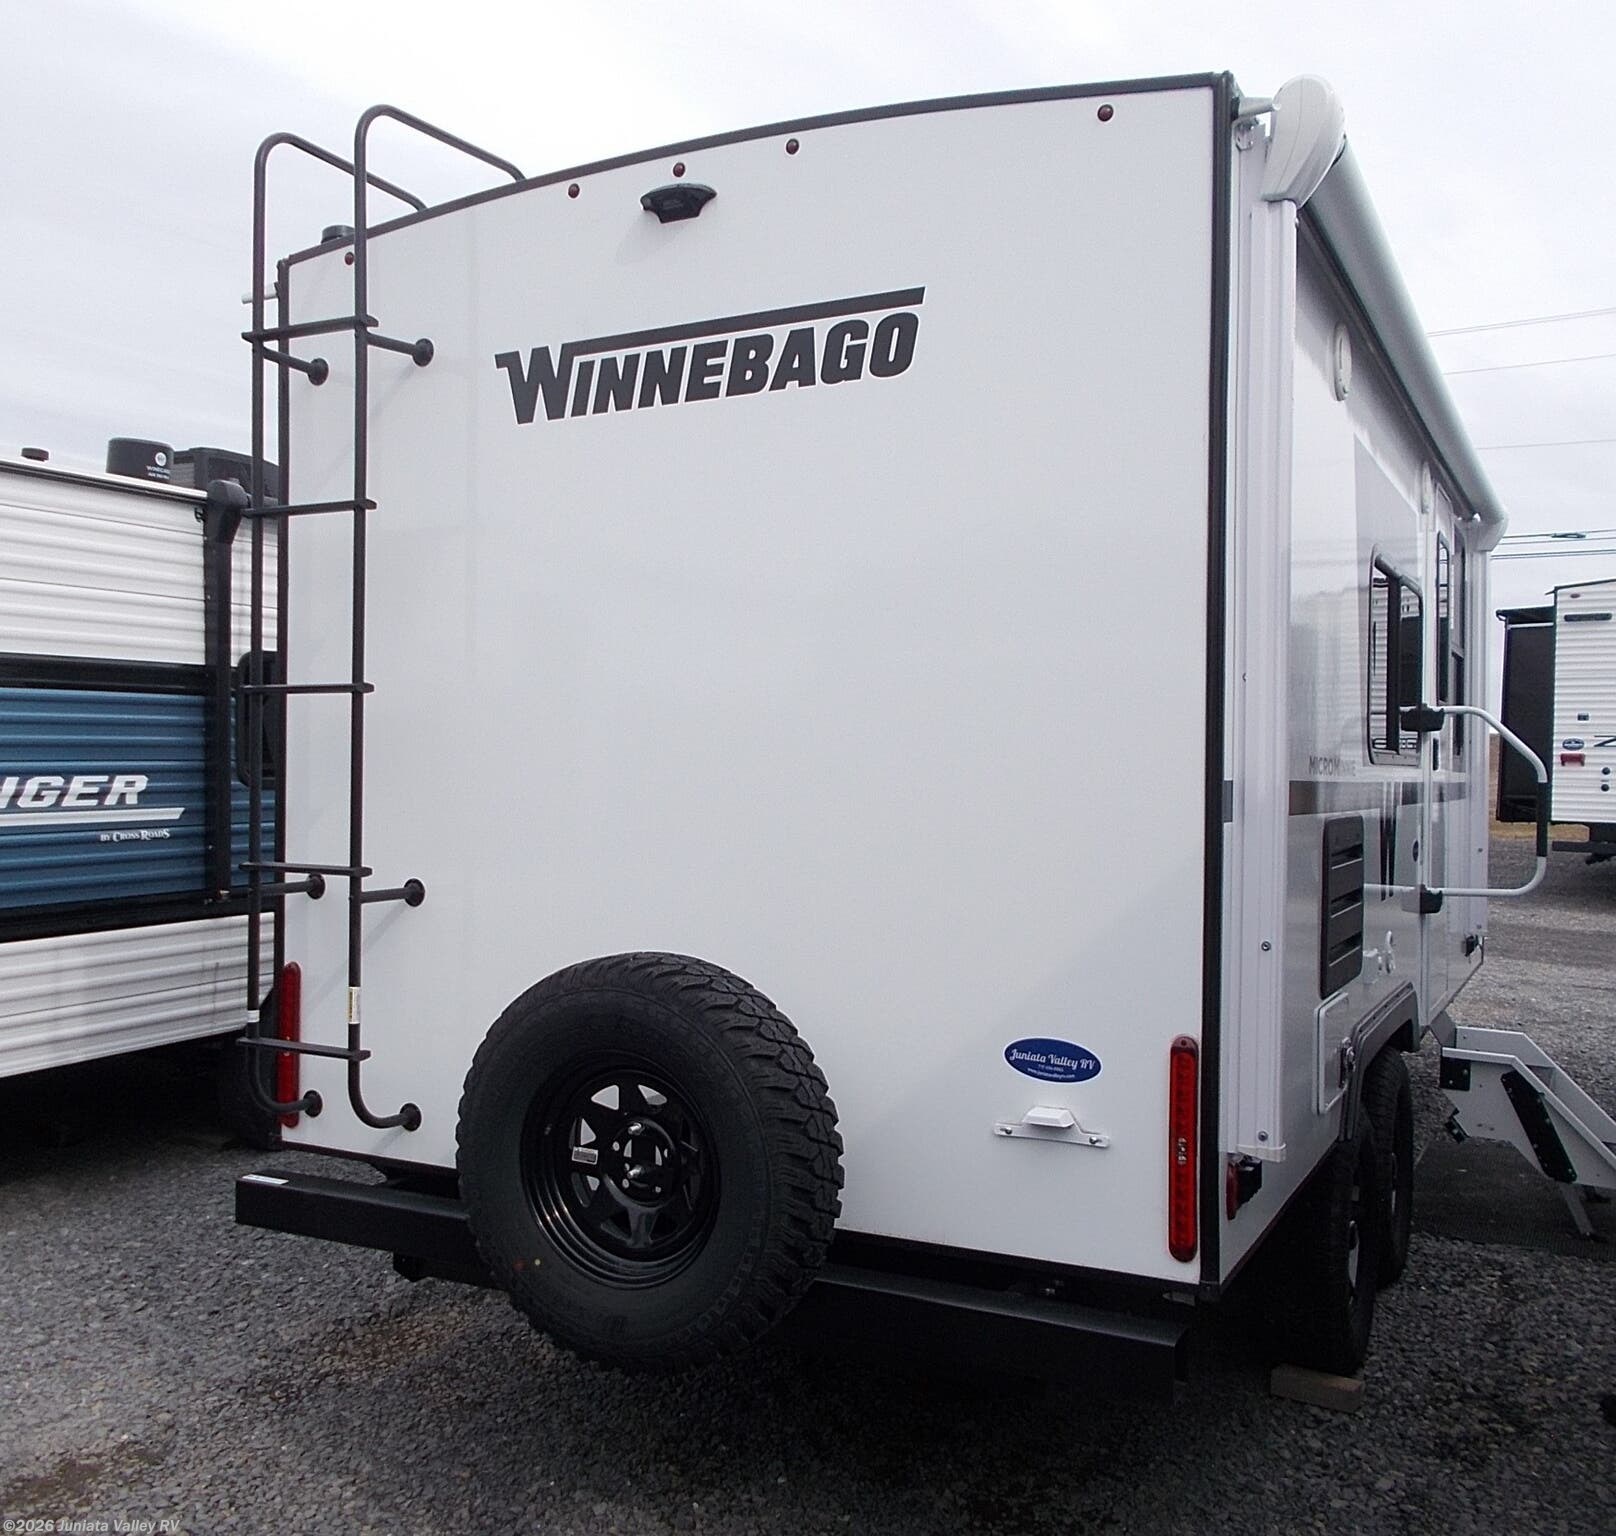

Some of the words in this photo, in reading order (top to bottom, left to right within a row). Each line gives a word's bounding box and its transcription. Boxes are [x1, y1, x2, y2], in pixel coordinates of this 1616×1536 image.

[495, 287, 925, 424] WINNEBAGO
[1009, 1048, 1046, 1063] Juniata
[1048, 1053, 1078, 1070] Valley
[1080, 1058, 1096, 1070] RV
